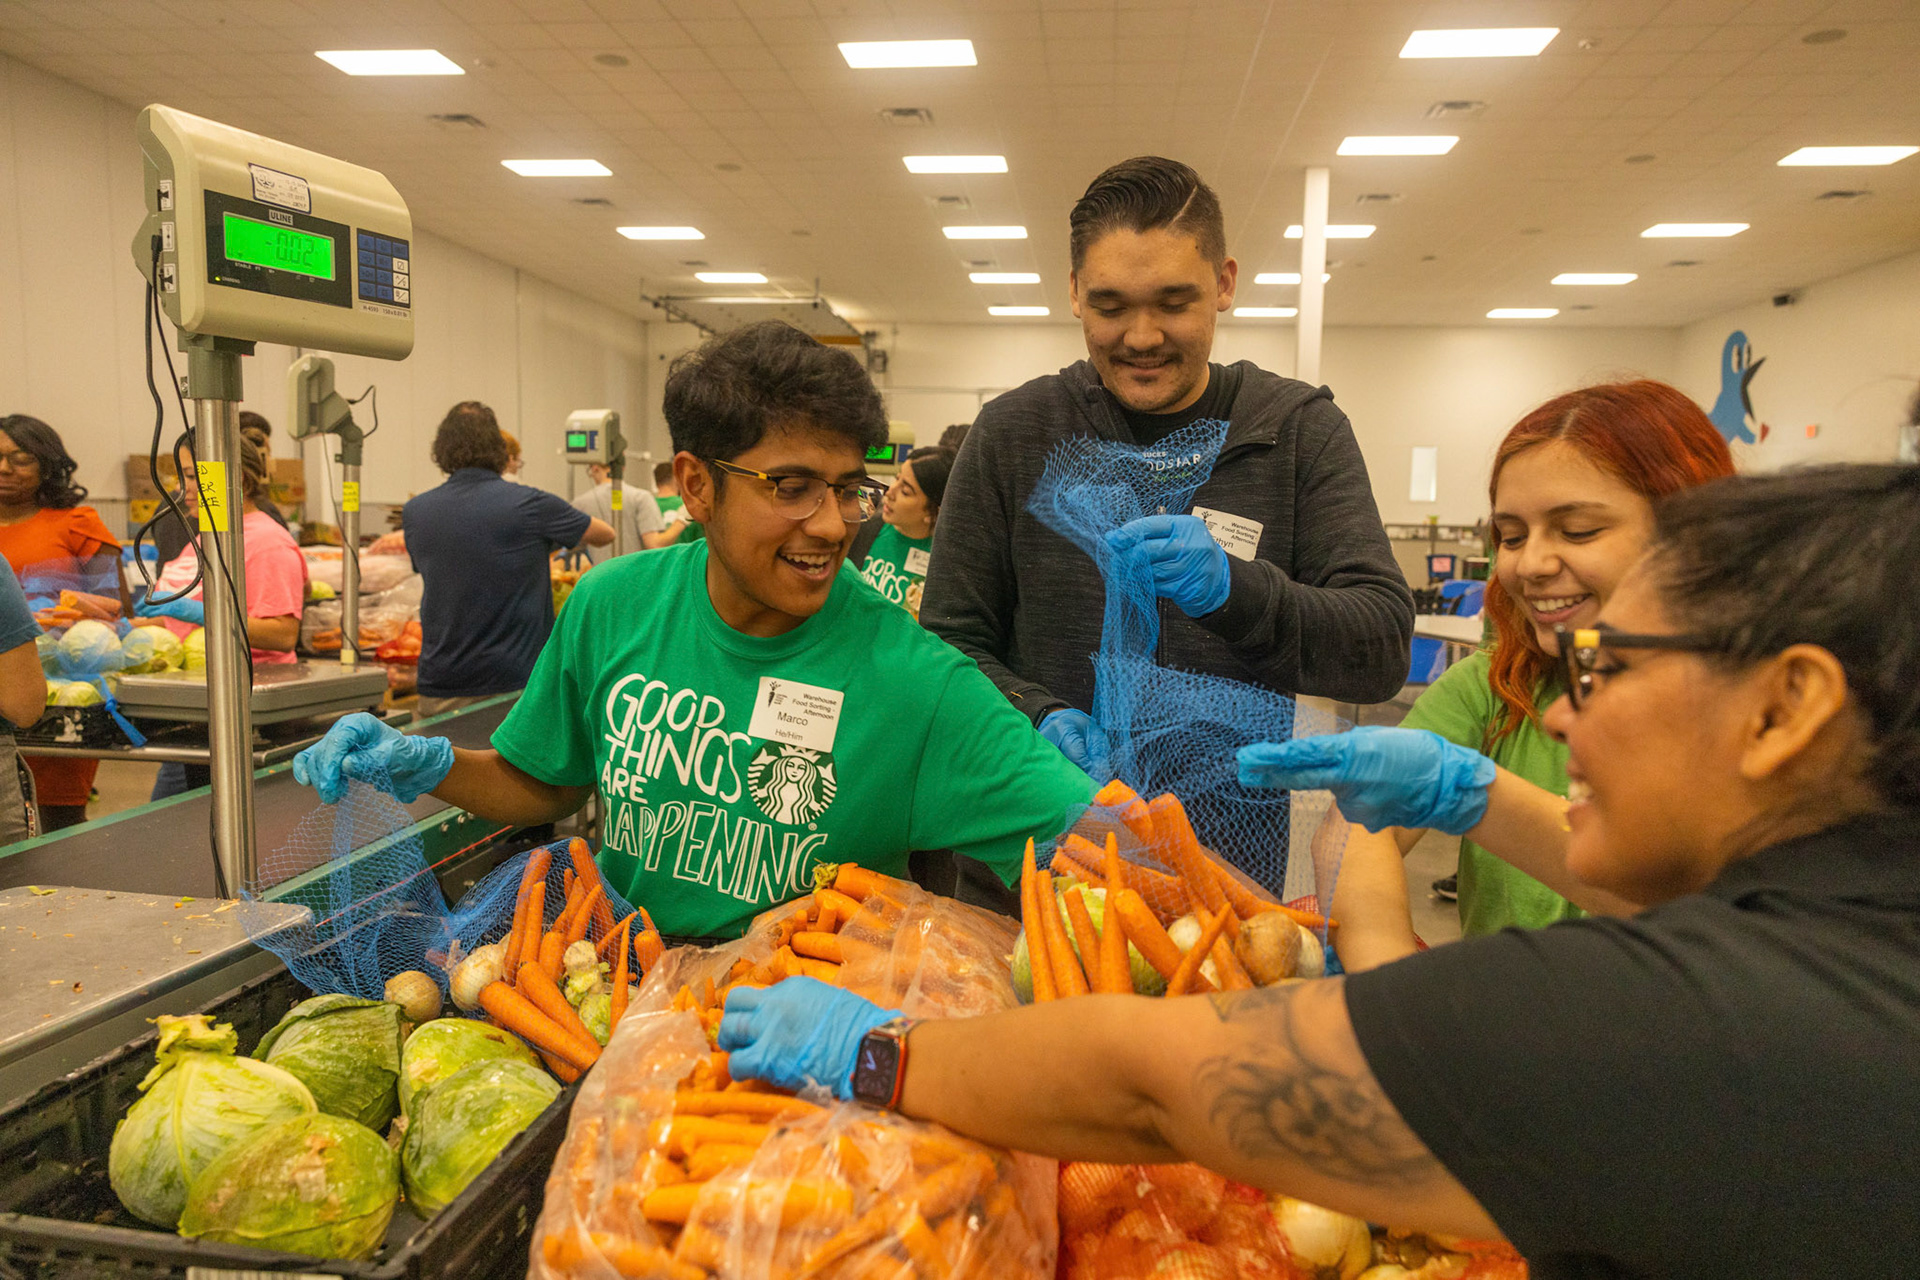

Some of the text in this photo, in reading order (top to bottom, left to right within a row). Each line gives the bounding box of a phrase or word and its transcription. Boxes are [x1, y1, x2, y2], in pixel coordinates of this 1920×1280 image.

[270, 212, 292, 224] ULINE
[1220, 525, 1236, 534] Food
[1236, 529, 1255, 541] Sorting
[1231, 522, 1259, 535] Warehouse
[1230, 534, 1257, 547] Afternoon
[792, 698, 808, 707] Food
[809, 701, 832, 713] Sorting
[803, 693, 837, 706] Warehouse
[605, 673, 726, 741] GOOD
[803, 708, 835, 720] Afternoon
[777, 711, 809, 726] Marco
[775, 728, 804, 741] He/Him
[604, 725, 753, 804] THINGS
[601, 760, 649, 804] ARE
